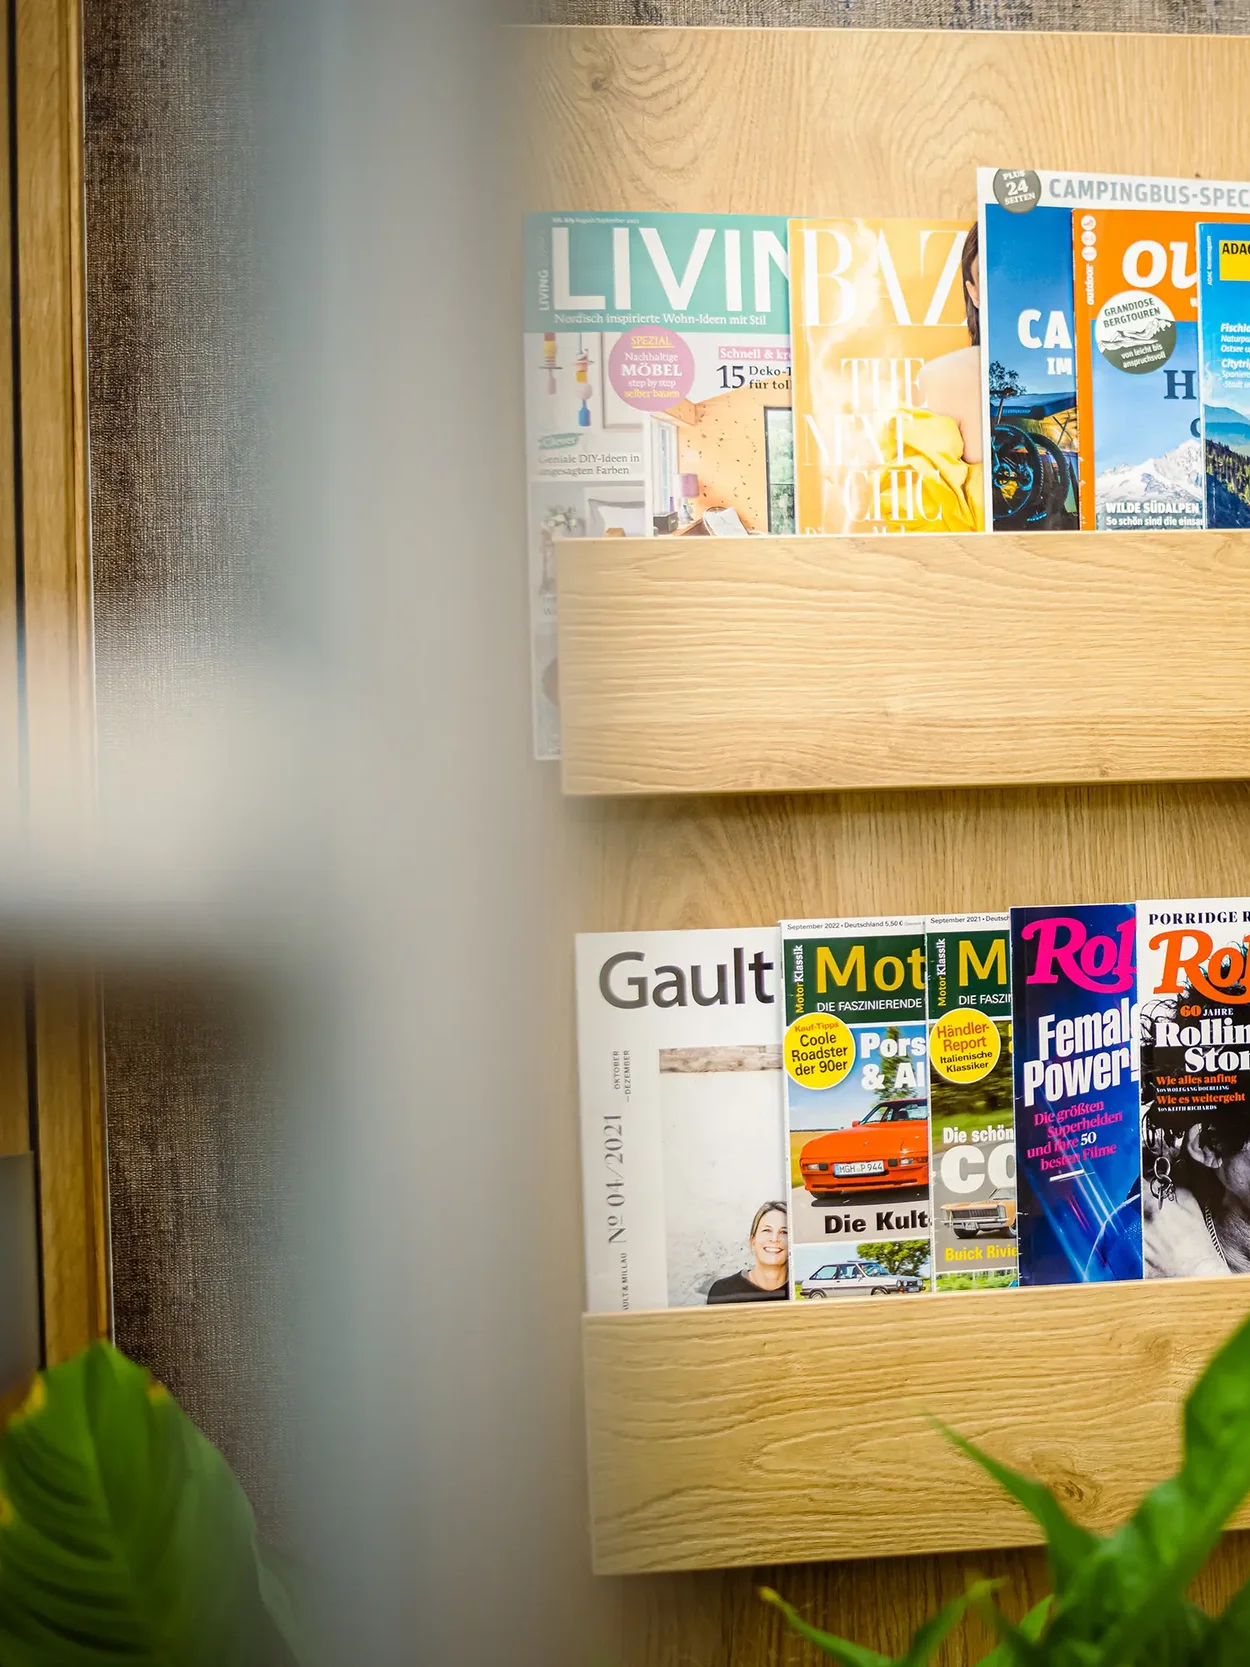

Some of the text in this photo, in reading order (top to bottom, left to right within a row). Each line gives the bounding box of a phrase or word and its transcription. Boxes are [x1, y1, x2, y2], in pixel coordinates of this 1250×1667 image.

[1002, 170, 1025, 181] PLUS
[1006, 179, 1029, 196] 24
[1004, 192, 1036, 206] SEITEN
[796, 228, 969, 328] BAZ
[1086, 263, 1095, 306] outdoor
[1104, 297, 1156, 318] GRANDIOSE
[555, 313, 767, 326] Nordisch inspirierte Wohn-Ideen mit Stil
[1103, 306, 1161, 329] BERGTOUREN
[1017, 308, 1072, 350] CA
[631, 335, 673, 345] SPEZIAL
[624, 352, 679, 363] Nachhaltige
[720, 347, 773, 359] Schnell &
[1220, 345, 1244, 354] Ostsee
[1047, 356, 1072, 376] IM
[1122, 351, 1167, 369] anspruchsvoll
[621, 362, 683, 377] MÖBEL
[716, 365, 745, 389] 15
[628, 379, 676, 388] step step
[749, 379, 769, 389] für
[840, 357, 928, 410] THE
[803, 413, 914, 467] NEXT
[579, 453, 640, 463] DIY-Ideen in
[596, 466, 629, 475] Farben
[843, 468, 943, 523] CHIC
[1105, 500, 1200, 514] WILDE SÜDALPEN
[1106, 516, 1177, 526] So schön sind die
[787, 921, 884, 931] September 2022 Deutschland
[930, 917, 966, 925] September
[966, 916, 982, 924] 2021
[1148, 910, 1239, 926] PORRIDGE
[816, 944, 926, 995] Mot
[959, 938, 1008, 988] M
[598, 946, 775, 1010] Gault
[817, 997, 923, 1013] DIE FASZINIERENDE
[958, 994, 978, 1005] DIE
[1180, 1004, 1234, 1018] 60 JAHRE
[794, 1021, 840, 1034] Kauf-Tipps
[936, 1020, 991, 1040] Händler-
[799, 1031, 838, 1048] Coole
[859, 1031, 926, 1059] Pors
[942, 1034, 988, 1054] Report
[791, 1045, 849, 1063] Roadster
[939, 1050, 994, 1065] Italienische
[613, 1049, 622, 1090] OKTOBER
[795, 1059, 849, 1077] der 90er
[946, 1060, 989, 1074] Klassiker
[861, 1063, 885, 1091] &
[1155, 1072, 1238, 1086] Wie alles anfing
[1156, 1091, 1246, 1105] Wie es weitergeht
[1033, 1099, 1105, 1127] Die größten
[1187, 1104, 1218, 1112] RICHARDS
[942, 1124, 1014, 1143] Die schön
[1047, 1110, 1123, 1140] Superhelden
[1026, 1131, 1097, 1160] und 50
[603, 1114, 627, 1210] 04/2021
[1040, 1141, 1117, 1172] besten Filme
[866, 1161, 884, 1173] 944
[824, 1208, 933, 1235] Die Kult
[944, 1247, 983, 1262] Buick
[621, 1252, 629, 1284] MILLAU
